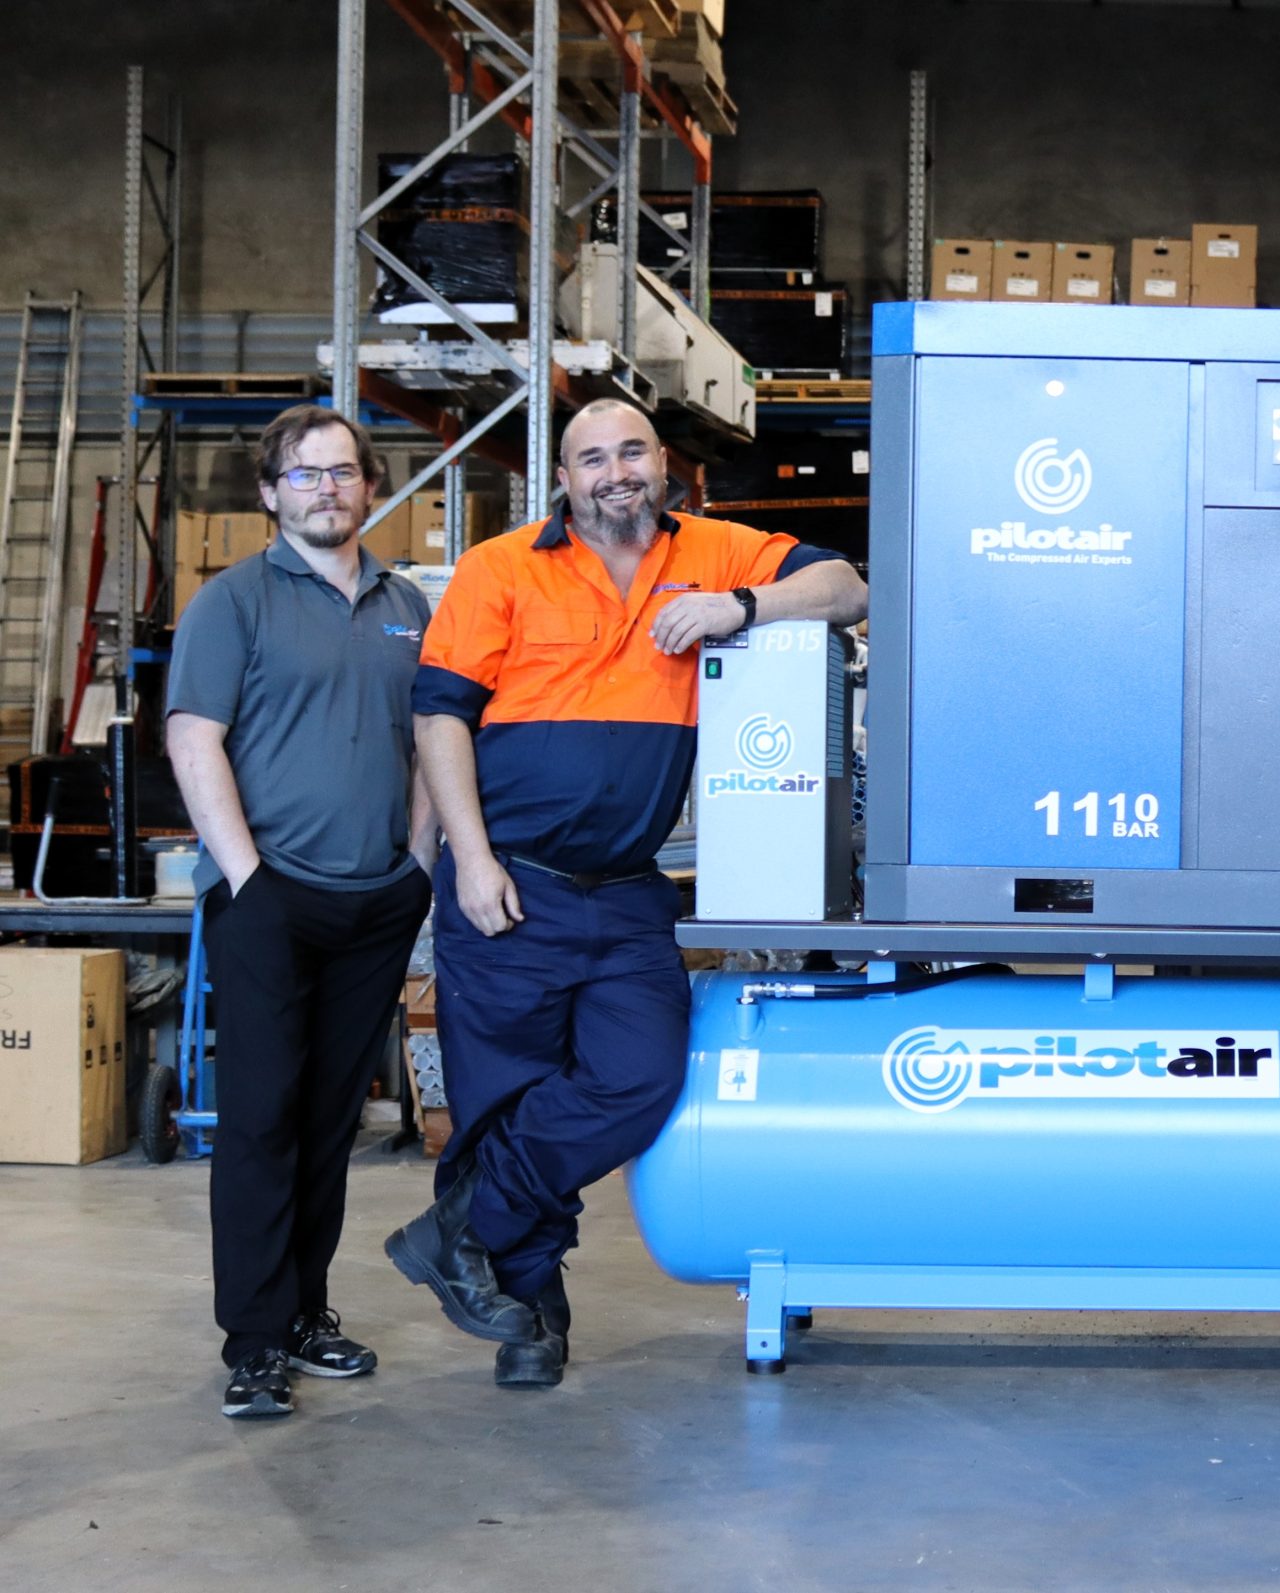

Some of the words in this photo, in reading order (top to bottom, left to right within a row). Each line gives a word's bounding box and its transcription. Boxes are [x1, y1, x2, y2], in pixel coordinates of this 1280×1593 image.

[970, 521, 1132, 554] pilotair
[987, 552, 1006, 562] The
[1007, 553, 1072, 564] Compressed
[1073, 554, 1090, 564] Air
[1091, 554, 1132, 565] Experts
[754, 629, 793, 652] TFD
[796, 628, 821, 652] 15
[707, 773, 819, 795] pilotair
[1034, 791, 1098, 836] 11
[1108, 793, 1159, 822] 10
[1112, 822, 1159, 838] BAR
[979, 1036, 1273, 1089] pilotair
